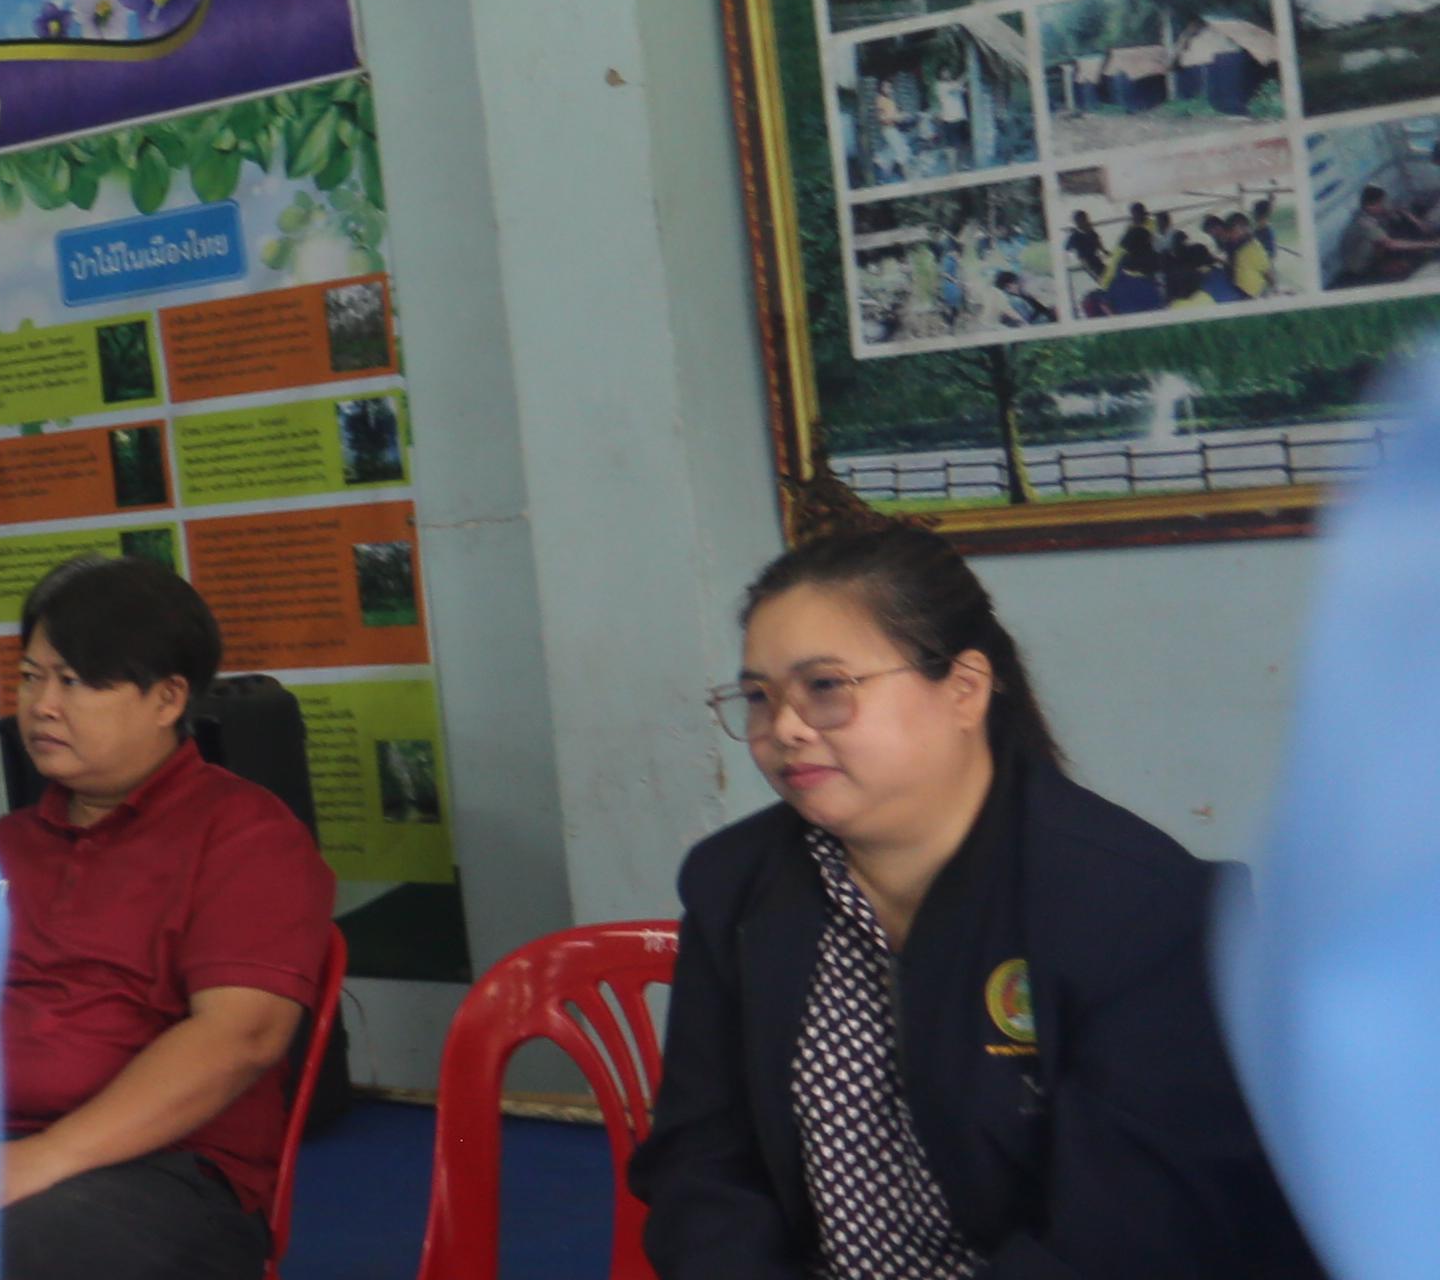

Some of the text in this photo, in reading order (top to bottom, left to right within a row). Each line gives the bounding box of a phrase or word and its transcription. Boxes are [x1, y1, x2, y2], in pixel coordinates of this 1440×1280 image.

[70, 230, 229, 280] ป่าไม้ในเมืองไทย
